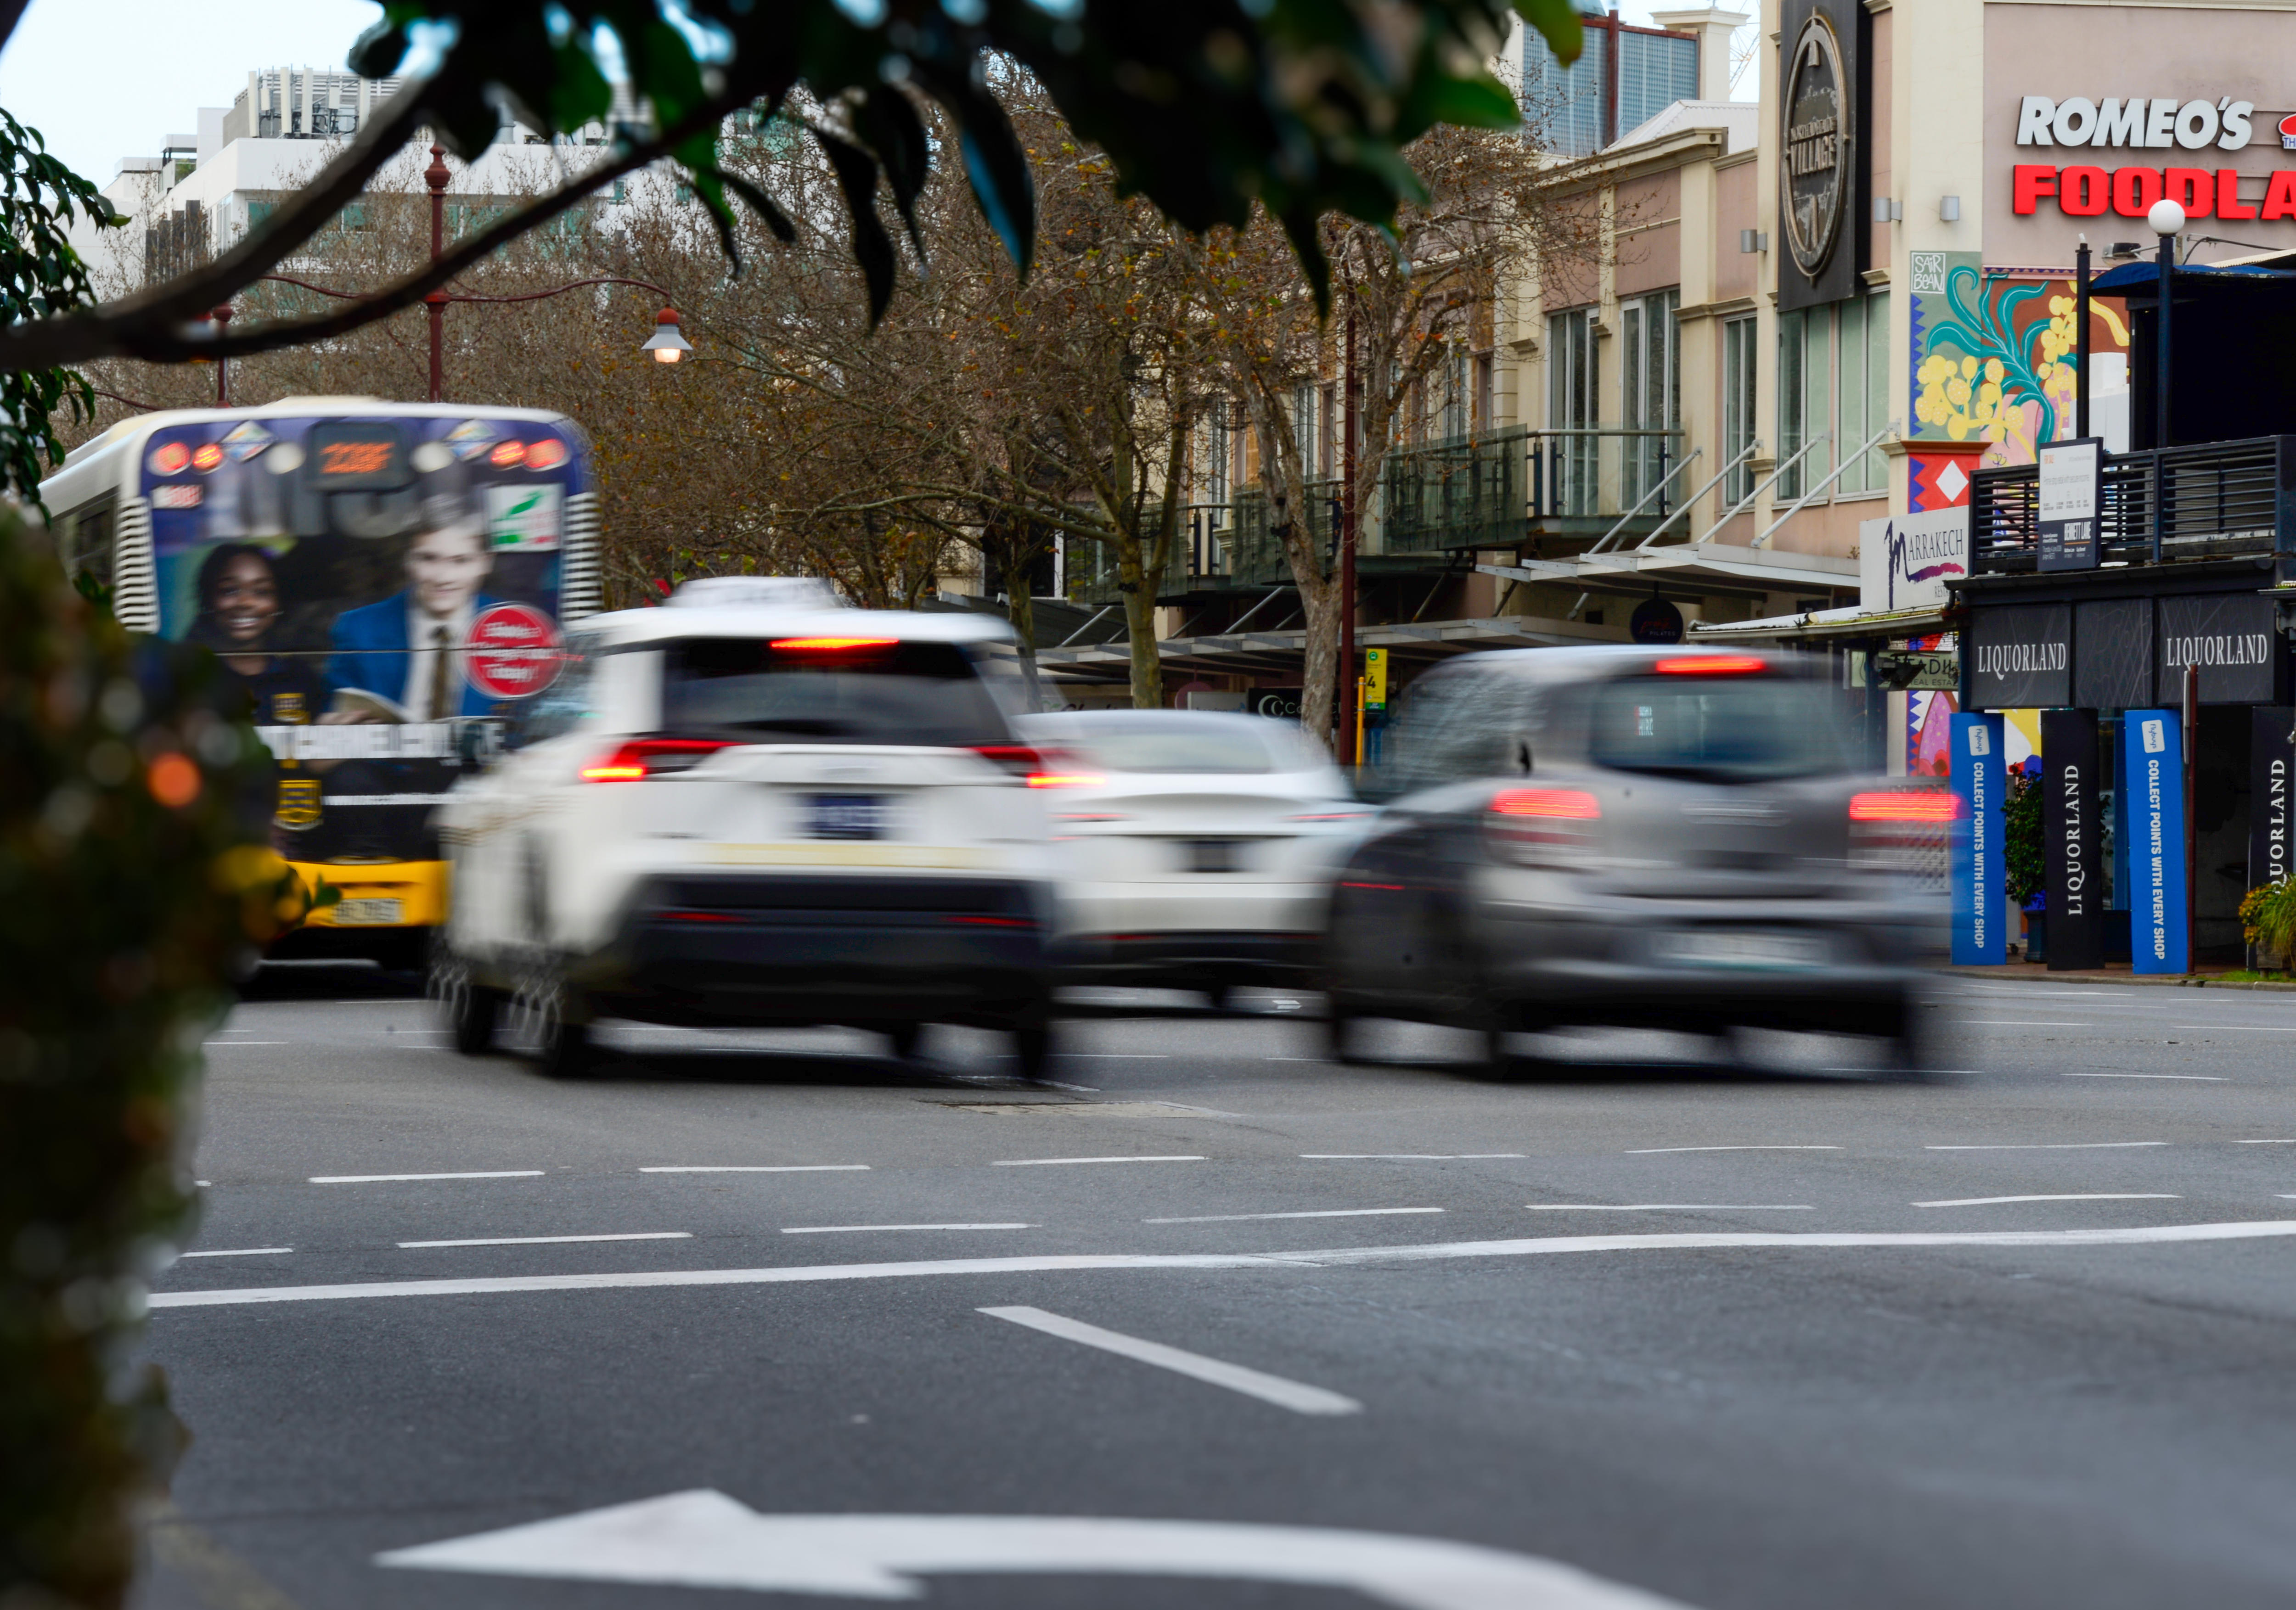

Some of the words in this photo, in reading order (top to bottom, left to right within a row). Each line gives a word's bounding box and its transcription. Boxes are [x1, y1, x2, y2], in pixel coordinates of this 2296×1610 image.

[2016, 96, 2254, 151] ROMEO'S
[1884, 520, 1964, 610] MARRAKECH
[1978, 643, 2066, 680] LIQUORLAND
[2167, 634, 2268, 671] LIQUORLAND
[1367, 675, 1376, 688] 4
[1975, 728, 1983, 752] flybuys
[2148, 724, 2157, 749] flybuys
[1974, 762, 1984, 809] COLLECT
[2148, 760, 2161, 810] COLLECT
[1974, 811, 1984, 851] POINTS
[2065, 765, 2085, 916] LIQUORLAND
[2150, 812, 2162, 854] POINTS
[2270, 760, 2287, 895] QUORLAND
[1974, 852, 1984, 881] WITH
[2151, 856, 2162, 886] WITH
[1974, 883, 1984, 916] EVERY
[2153, 889, 2164, 926] EVERY
[1975, 918, 1985, 948] SHOP
[2154, 927, 2165, 959] SHOP
